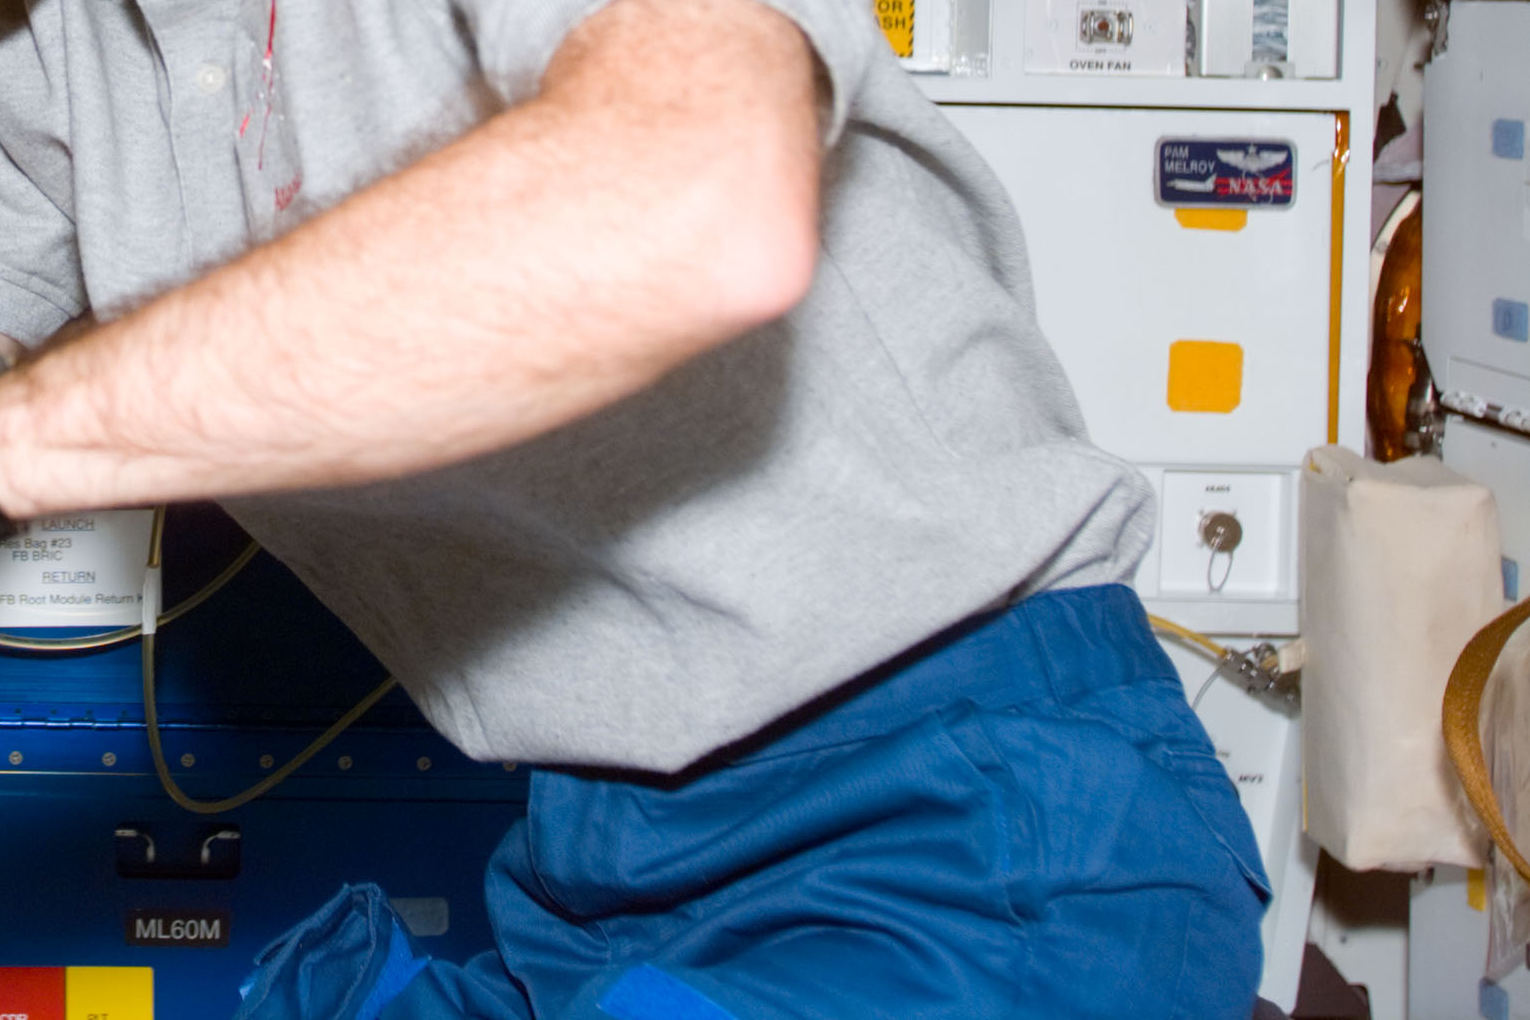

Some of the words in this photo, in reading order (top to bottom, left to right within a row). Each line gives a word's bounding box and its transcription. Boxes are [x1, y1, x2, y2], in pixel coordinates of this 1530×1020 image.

[877, 0, 903, 13] OR
[1070, 60, 1103, 71] OVEN
[1107, 60, 1131, 71] FAN
[1165, 146, 1189, 159] PAM
[1165, 160, 1216, 174] MELROY
[1229, 178, 1284, 195] NASA
[42, 518, 95, 530] LAUNCH
[24, 538, 47, 551] Bag
[51, 538, 72, 549] #23
[12, 551, 29, 561] FB
[32, 551, 63, 561] BRIC
[42, 571, 96, 583] RETURN
[0, 595, 16, 605] FB
[20, 594, 46, 605] Root
[49, 594, 92, 605] Module
[95, 593, 134, 605] Return
[135, 918, 220, 940] ML60M
